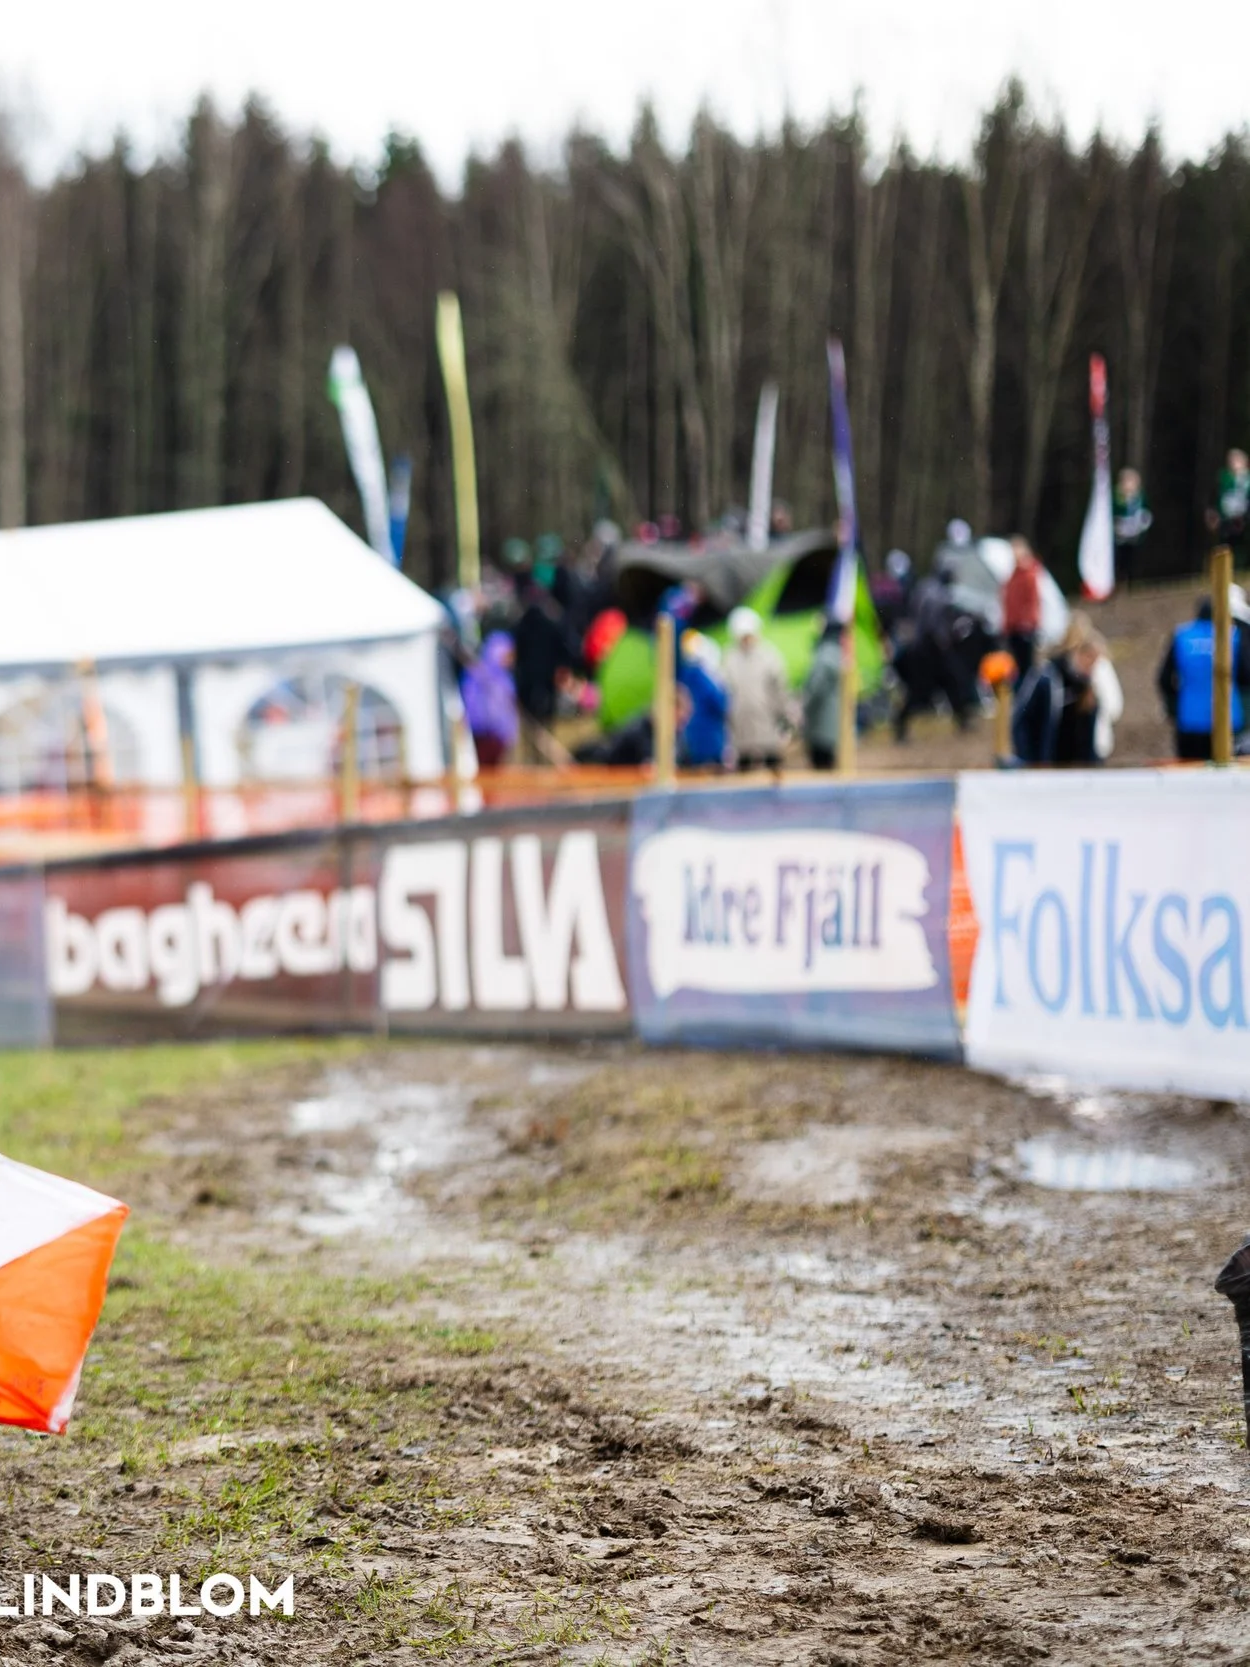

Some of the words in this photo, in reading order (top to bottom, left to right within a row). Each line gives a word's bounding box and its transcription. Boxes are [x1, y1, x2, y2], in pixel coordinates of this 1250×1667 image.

[49, 881, 379, 1007] bagheera
[380, 829, 628, 1012] SILVA
[680, 861, 763, 949] Idre
[775, 859, 883, 972] Fjäll
